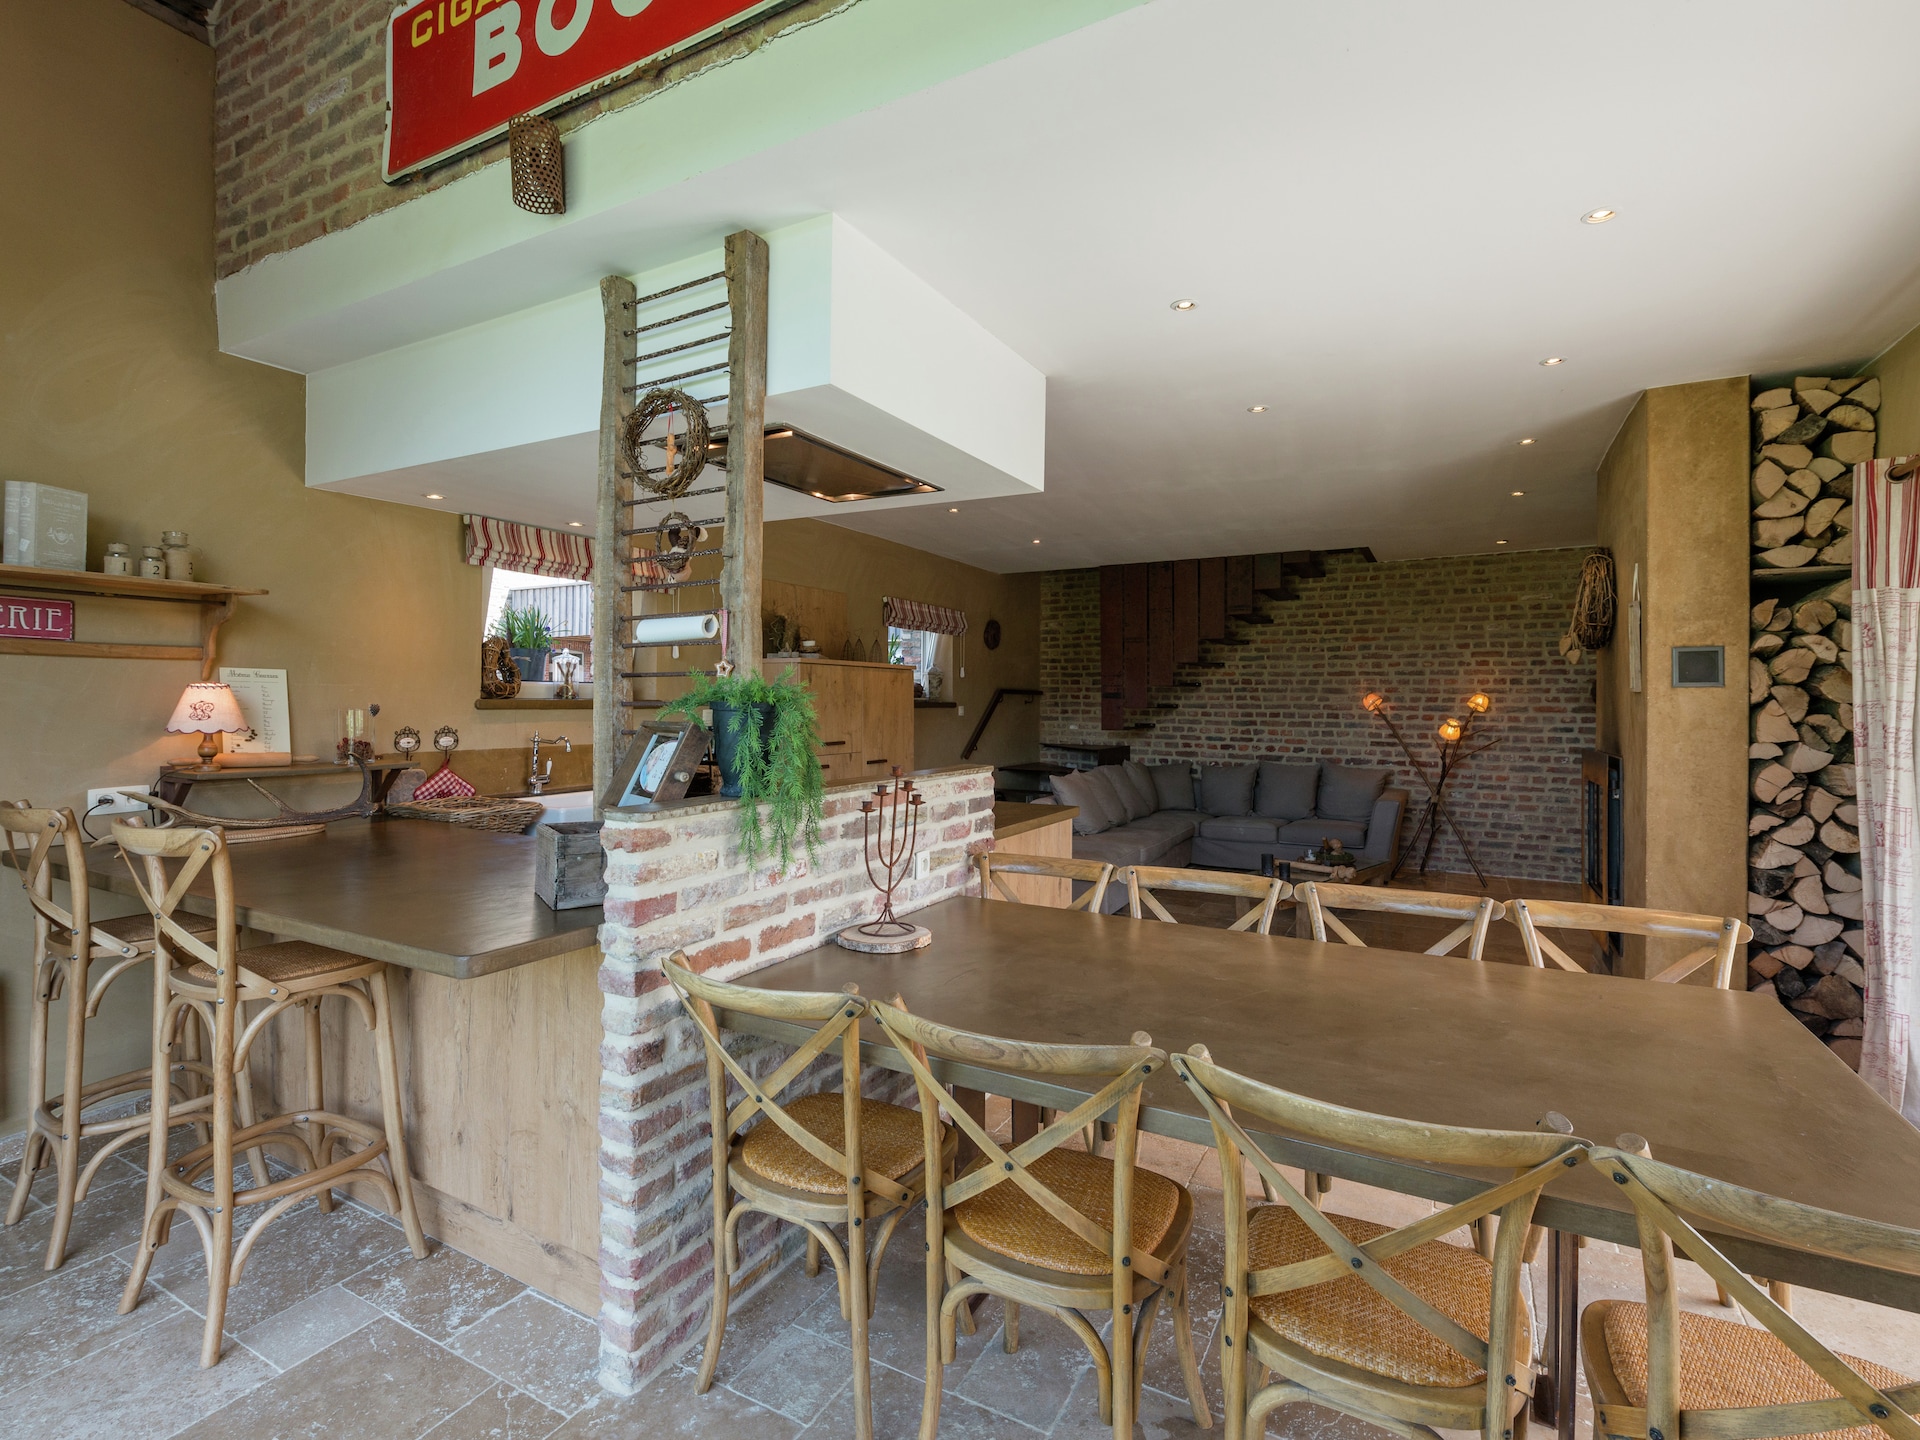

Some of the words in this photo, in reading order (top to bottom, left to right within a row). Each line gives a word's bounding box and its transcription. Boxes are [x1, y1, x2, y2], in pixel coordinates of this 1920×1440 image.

[472, 0, 653, 97] BO
[152, 565, 160, 575] 2
[188, 562, 194, 575] 3
